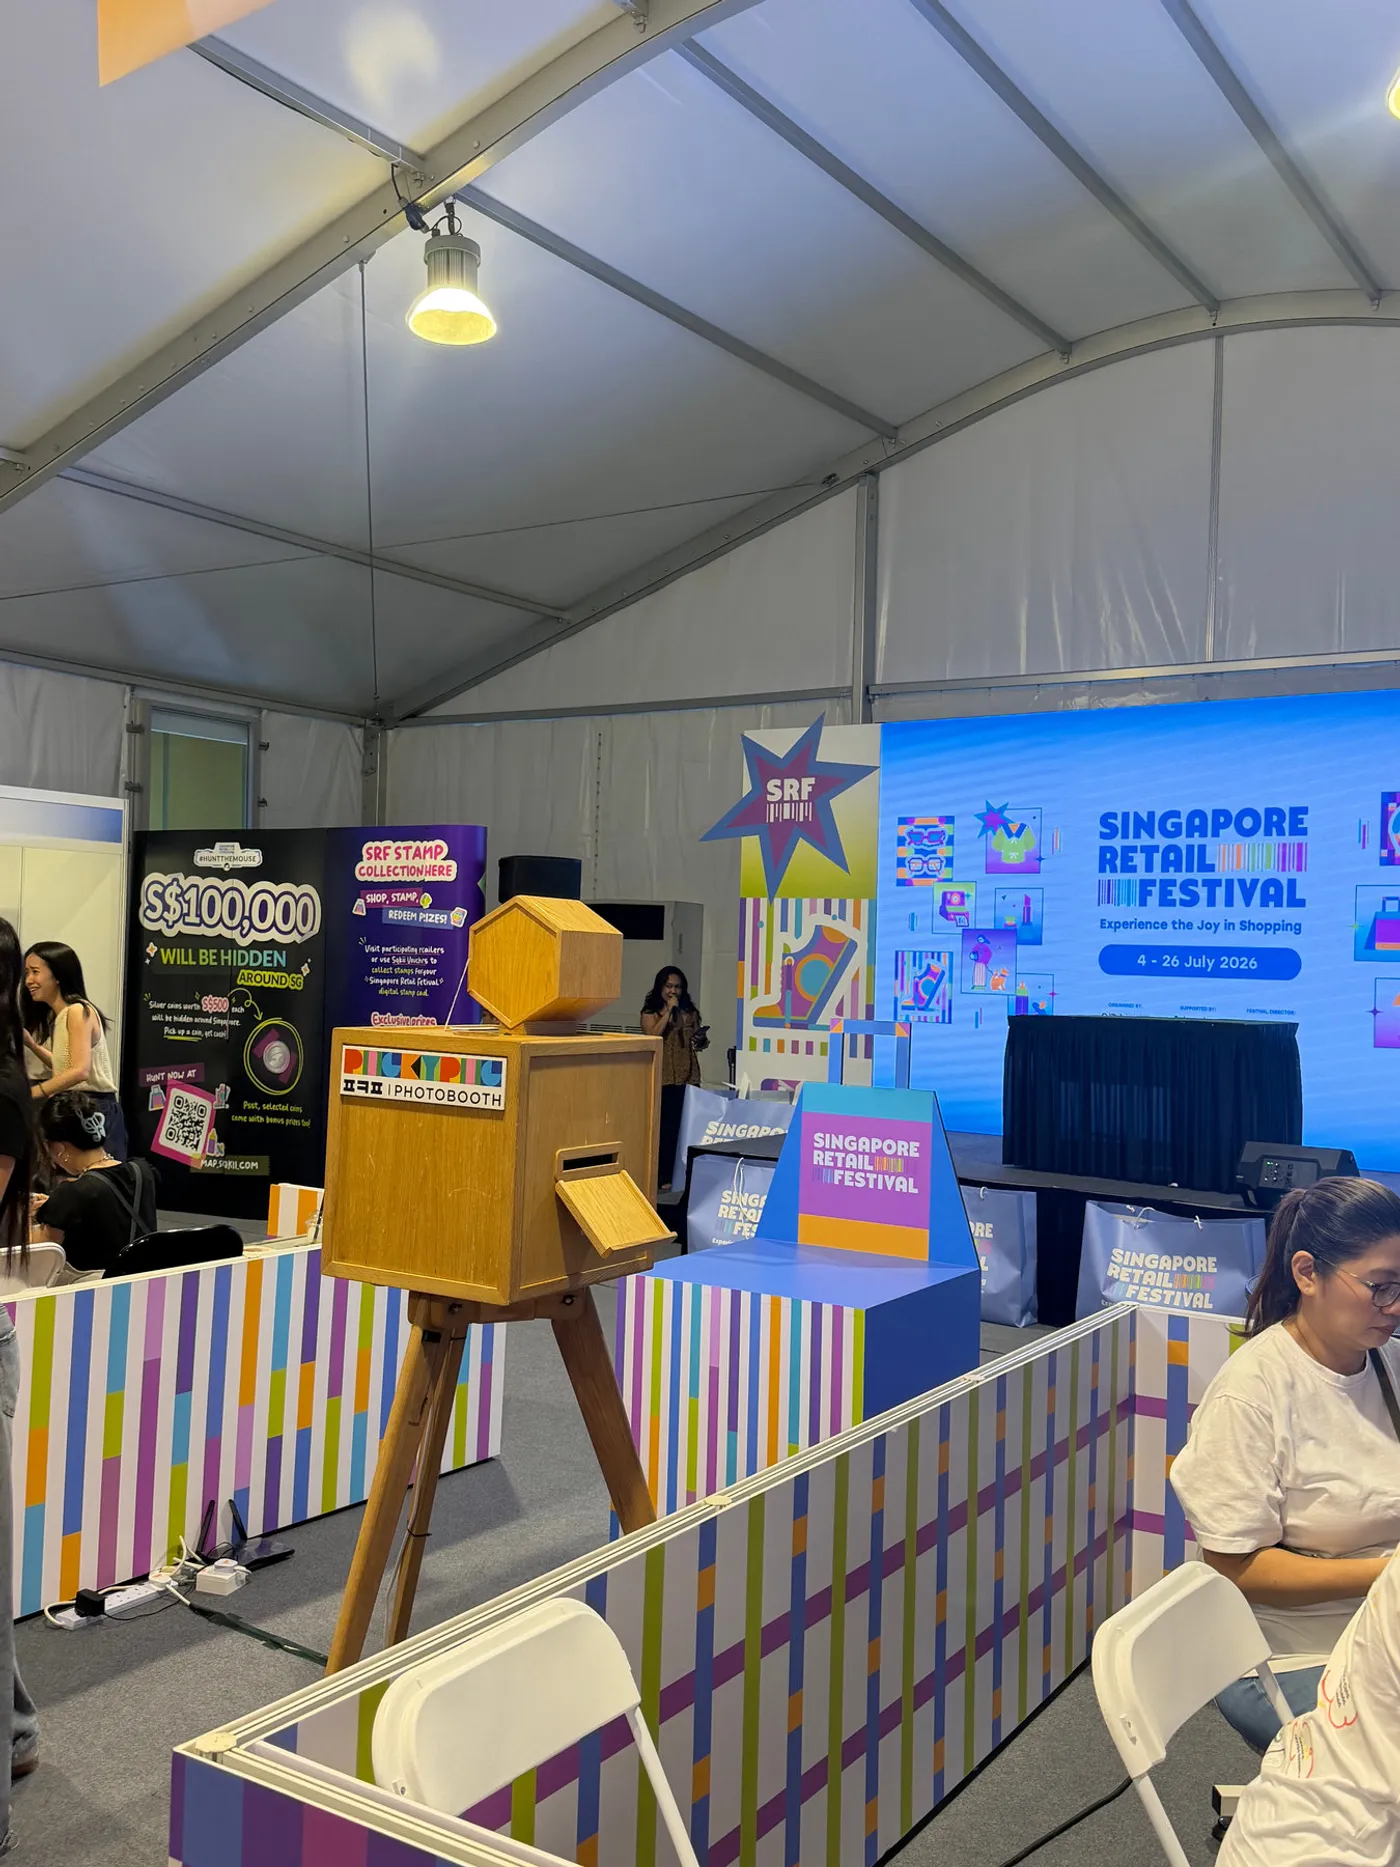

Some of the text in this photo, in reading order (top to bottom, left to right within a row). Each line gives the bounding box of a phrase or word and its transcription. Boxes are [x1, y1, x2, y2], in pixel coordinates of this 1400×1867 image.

[766, 777, 816, 802] SRF
[1099, 806, 1309, 840] SINGAPORE
[365, 844, 444, 860] SRF STAMP
[1098, 844, 1216, 874] RETAIL
[359, 864, 453, 877] COLLECTION HERE
[366, 892, 419, 904] SHOP, STAMP,
[1138, 878, 1307, 908] FESTIVAL
[144, 878, 316, 938] S$100,000
[388, 910, 417, 921] REDEEM
[1100, 918, 1302, 935] Experience the Joy in Shopping
[160, 948, 286, 967] WILL BE HIDDEN
[364, 945, 380, 953] Visit
[381, 945, 418, 954] participating
[371, 966, 393, 974] collect
[394, 967, 414, 975] stamps
[1137, 954, 1147, 966] 4
[1162, 955, 1180, 967] 26
[1184, 955, 1215, 971] July
[1220, 957, 1258, 969] 2026
[239, 972, 303, 987] AROUND SG
[369, 976, 399, 985] Singapore
[400, 977, 416, 985] Retail
[378, 987, 399, 996] digital
[400, 989, 415, 997] stamp
[149, 1000, 166, 1009] Silver
[203, 997, 228, 1012] S$500
[194, 1016, 212, 1024] around
[372, 1013, 436, 1026] Exclusive prizes
[164, 1026, 176, 1035] Pick
[205, 1030, 213, 1038] get
[146, 1069, 197, 1082] HUNT NOW AT
[343, 1048, 503, 1088] PICKYPIC
[394, 1085, 502, 1107] PHOTOBOOTH
[243, 1101, 261, 1111] Psst,
[262, 1102, 289, 1111] selected
[249, 1115, 264, 1123] with
[266, 1116, 284, 1124] bonus
[813, 1132, 920, 1158] SINGAPORE
[813, 1149, 874, 1171] RETAIL
[833, 1169, 919, 1194] FESTIVAL
[1111, 1247, 1218, 1273] SINGAPORE
[1106, 1262, 1173, 1288] RETAIL
[1125, 1284, 1213, 1309] FESTIVAL
